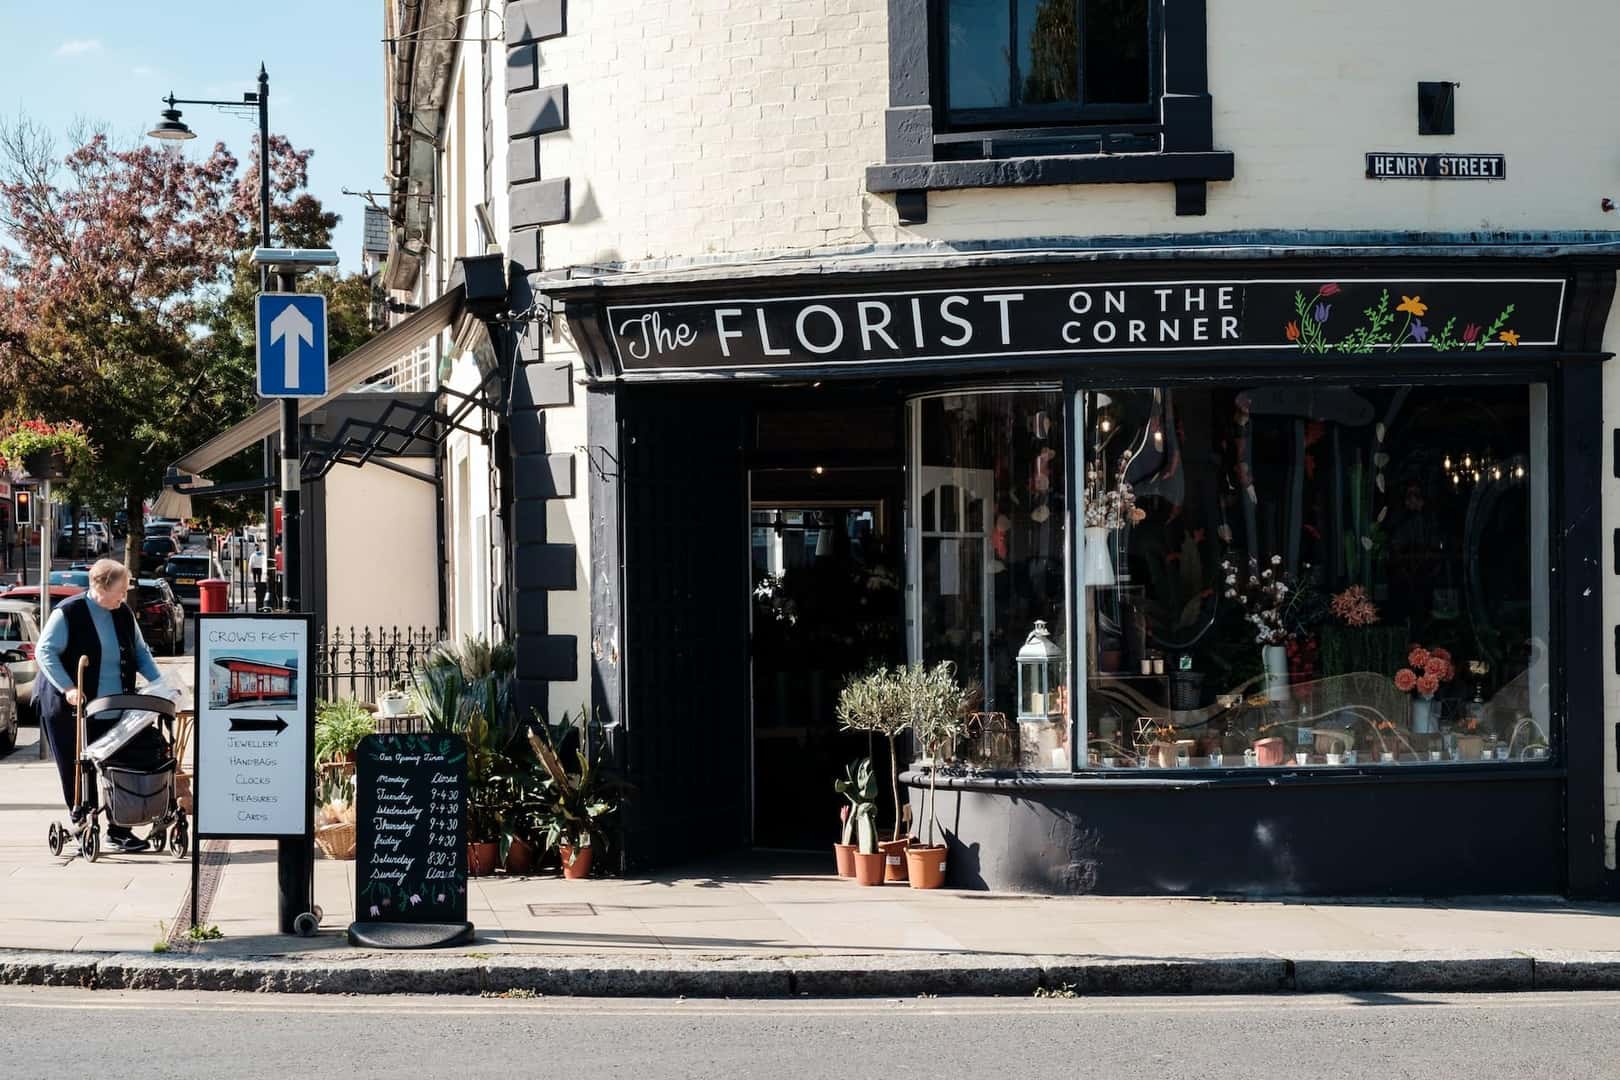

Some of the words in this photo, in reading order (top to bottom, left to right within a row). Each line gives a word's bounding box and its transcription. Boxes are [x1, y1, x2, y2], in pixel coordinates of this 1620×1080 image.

[1375, 156, 1428, 175] HENRY
[1440, 157, 1499, 176] STREET
[1068, 290, 1126, 314] ON
[1154, 286, 1234, 312] THE
[619, 310, 698, 360] The
[714, 293, 1025, 358] FLORIST
[1061, 316, 1239, 344] CORNER
[208, 630, 257, 642] CROWS
[261, 631, 300, 641] FEET
[376, 774, 410, 788] Monday
[376, 787, 414, 805] Tuesday
[376, 804, 423, 820] Wednesday
[372, 816, 416, 837] Thursday
[369, 852, 416, 871] Saturday
[369, 868, 407, 886] Sunday
